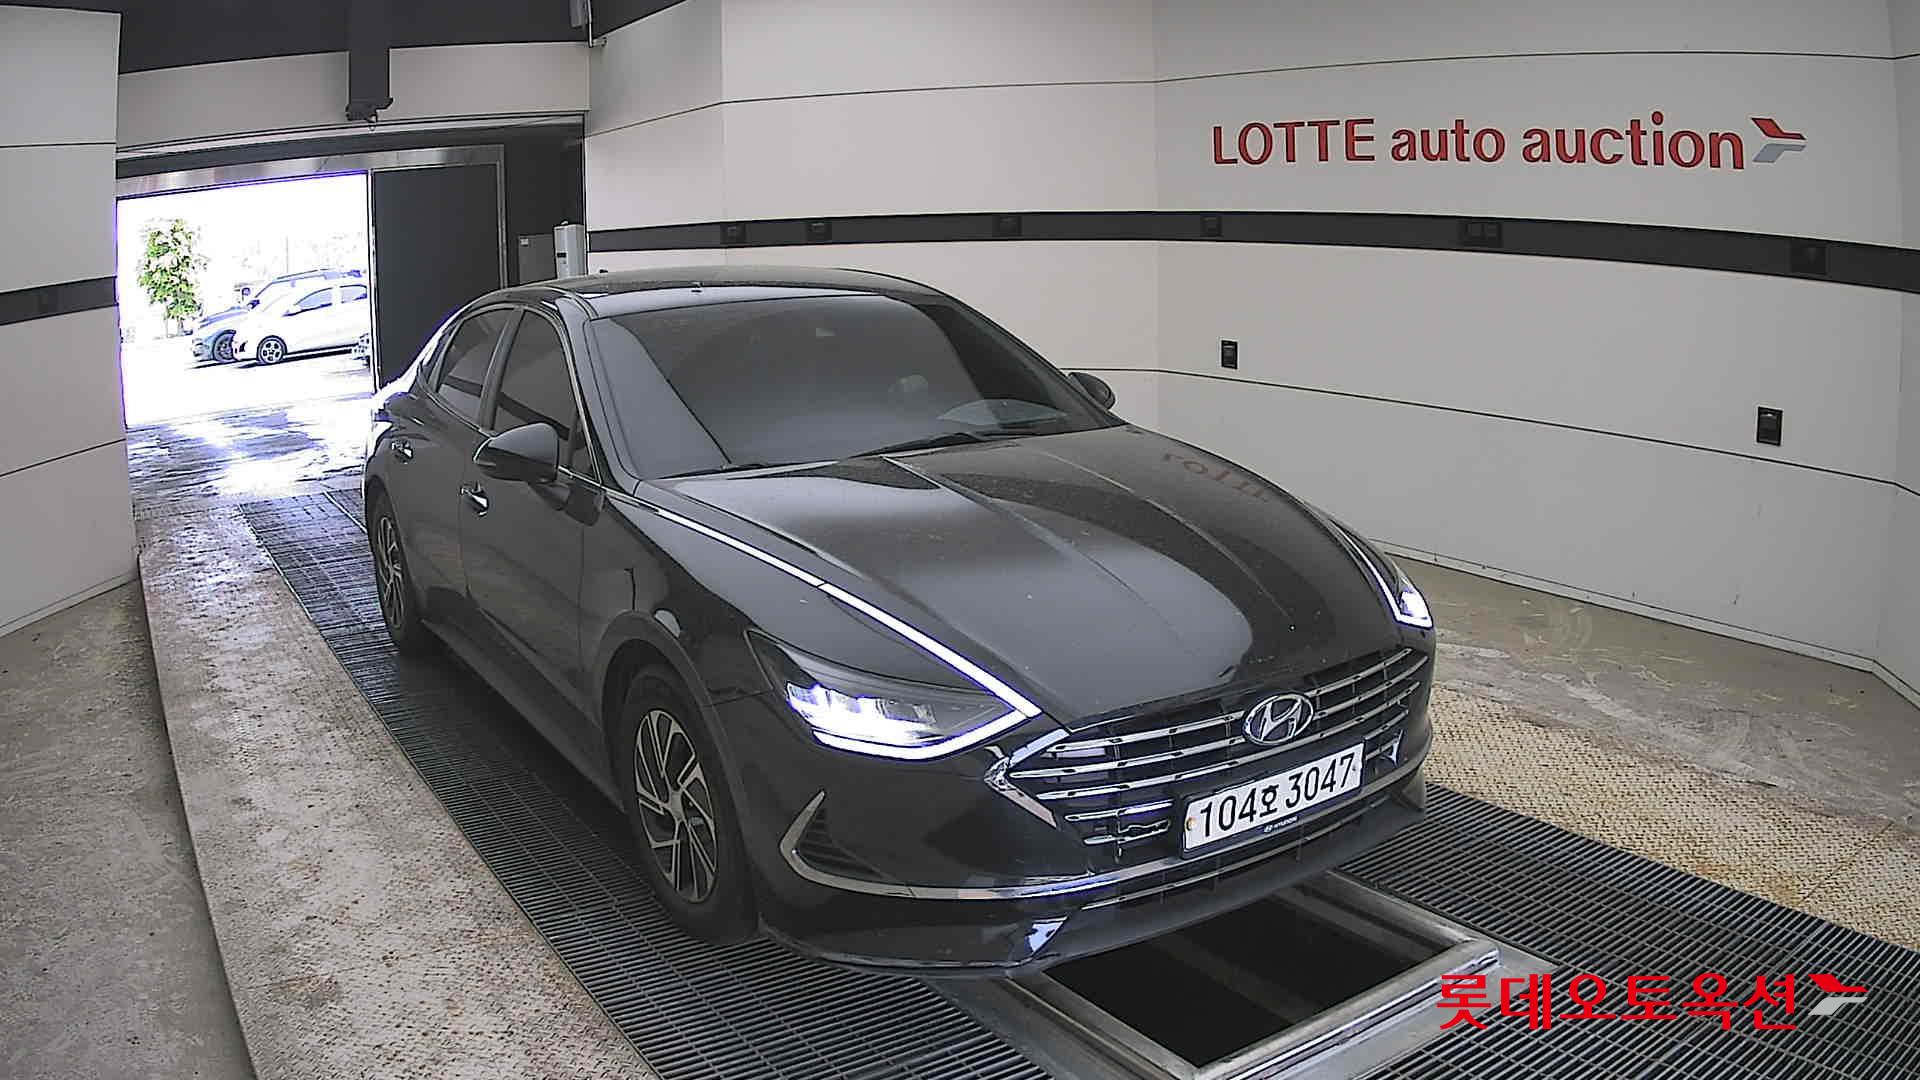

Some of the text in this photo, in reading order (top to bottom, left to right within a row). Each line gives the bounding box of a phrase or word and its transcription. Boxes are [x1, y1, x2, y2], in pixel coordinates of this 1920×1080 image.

[1213, 111, 1745, 170] LOTTE auto auction
[1200, 752, 1355, 838] 104호 3047
